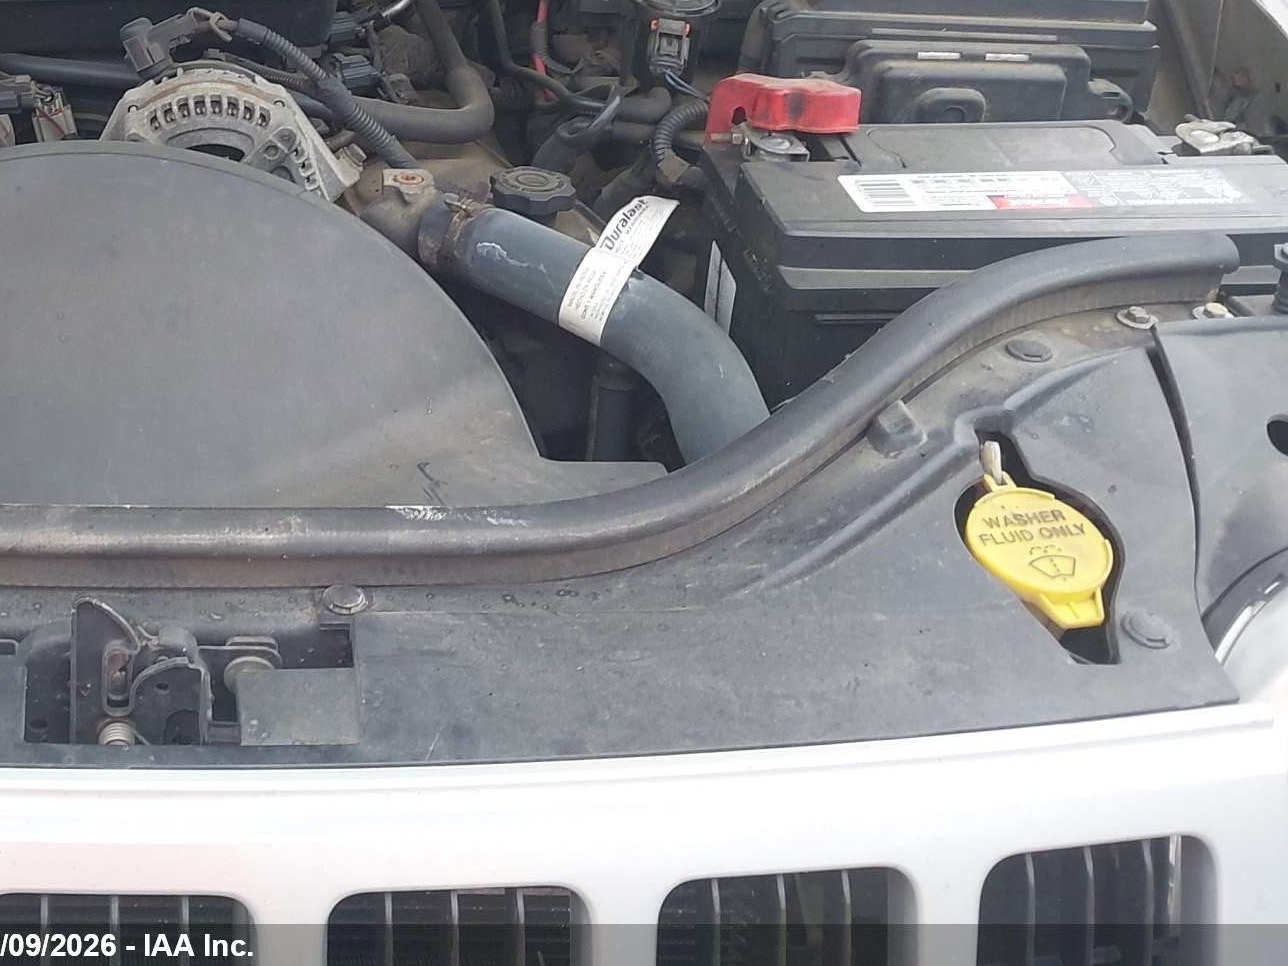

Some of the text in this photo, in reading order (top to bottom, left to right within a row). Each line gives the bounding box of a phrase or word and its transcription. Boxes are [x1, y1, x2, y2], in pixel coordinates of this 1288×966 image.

[600, 199, 648, 251] Duralast
[982, 509, 1066, 529] WASHER
[978, 522, 1087, 546] FLUID ONLY
